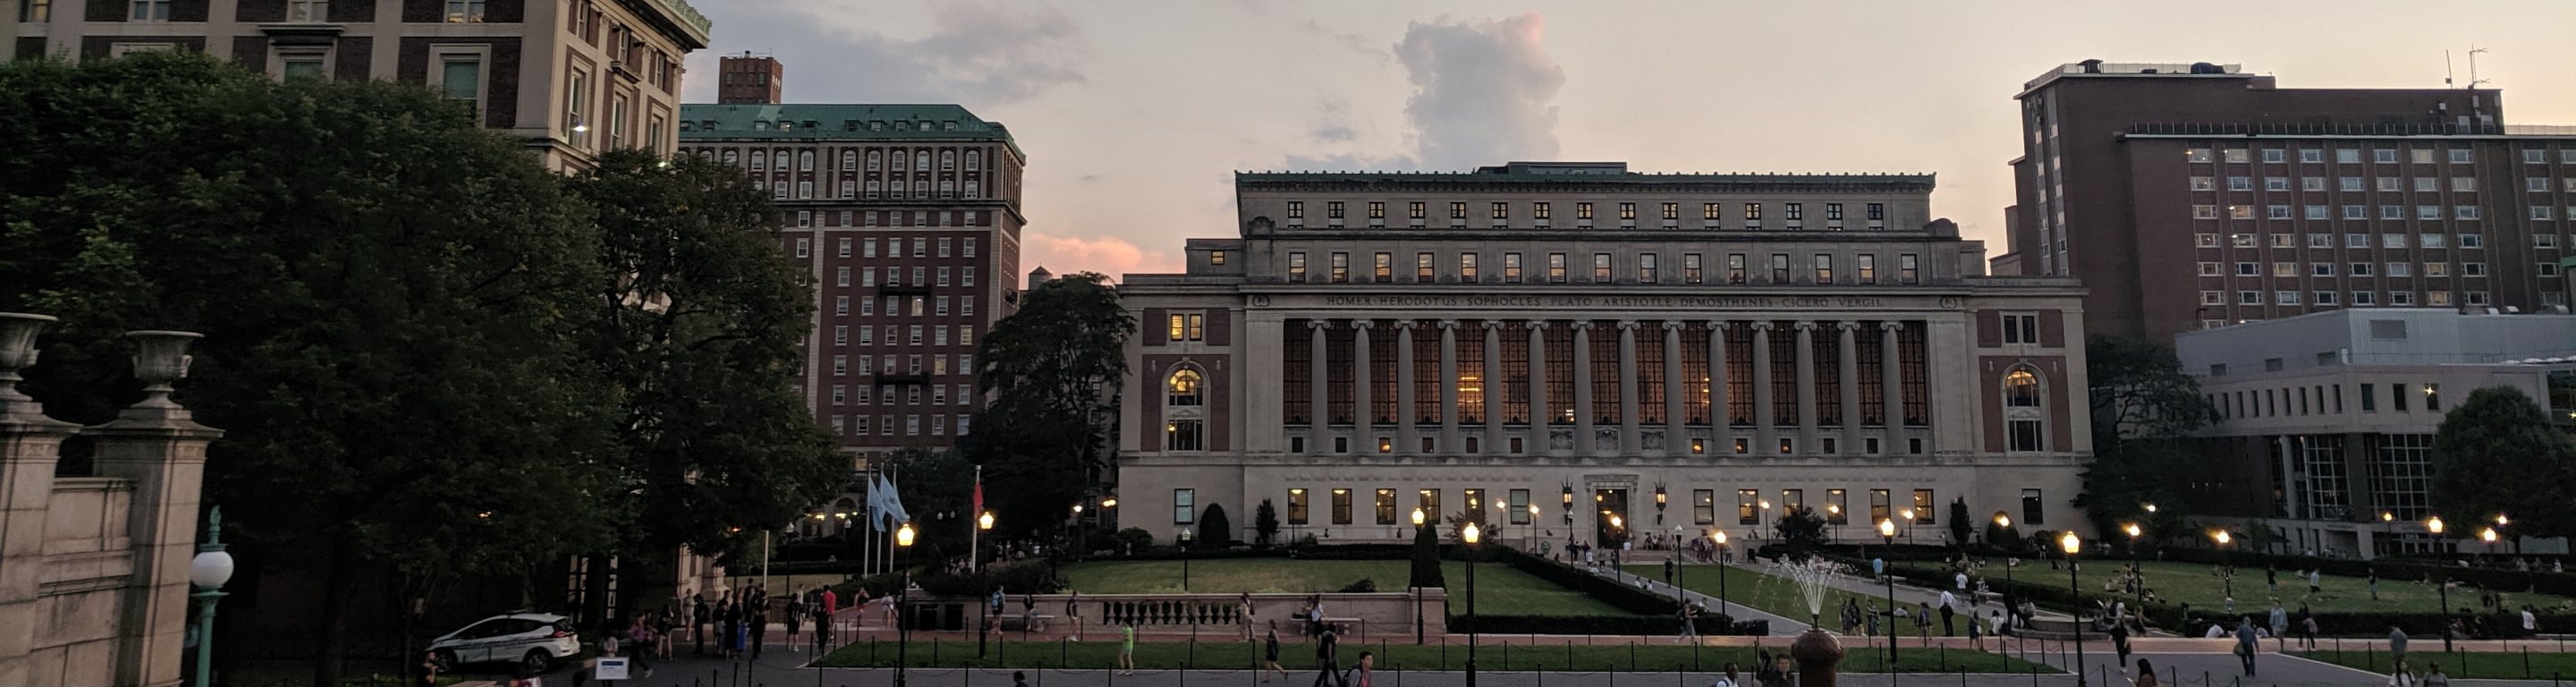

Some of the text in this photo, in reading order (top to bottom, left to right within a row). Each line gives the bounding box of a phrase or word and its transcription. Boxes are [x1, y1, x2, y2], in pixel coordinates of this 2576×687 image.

[1326, 296, 1883, 308] HOMER HERODOTUS SOPHOCLES PLATO ARISTOTLE DEMOSTHENES CICERO VERGIL
